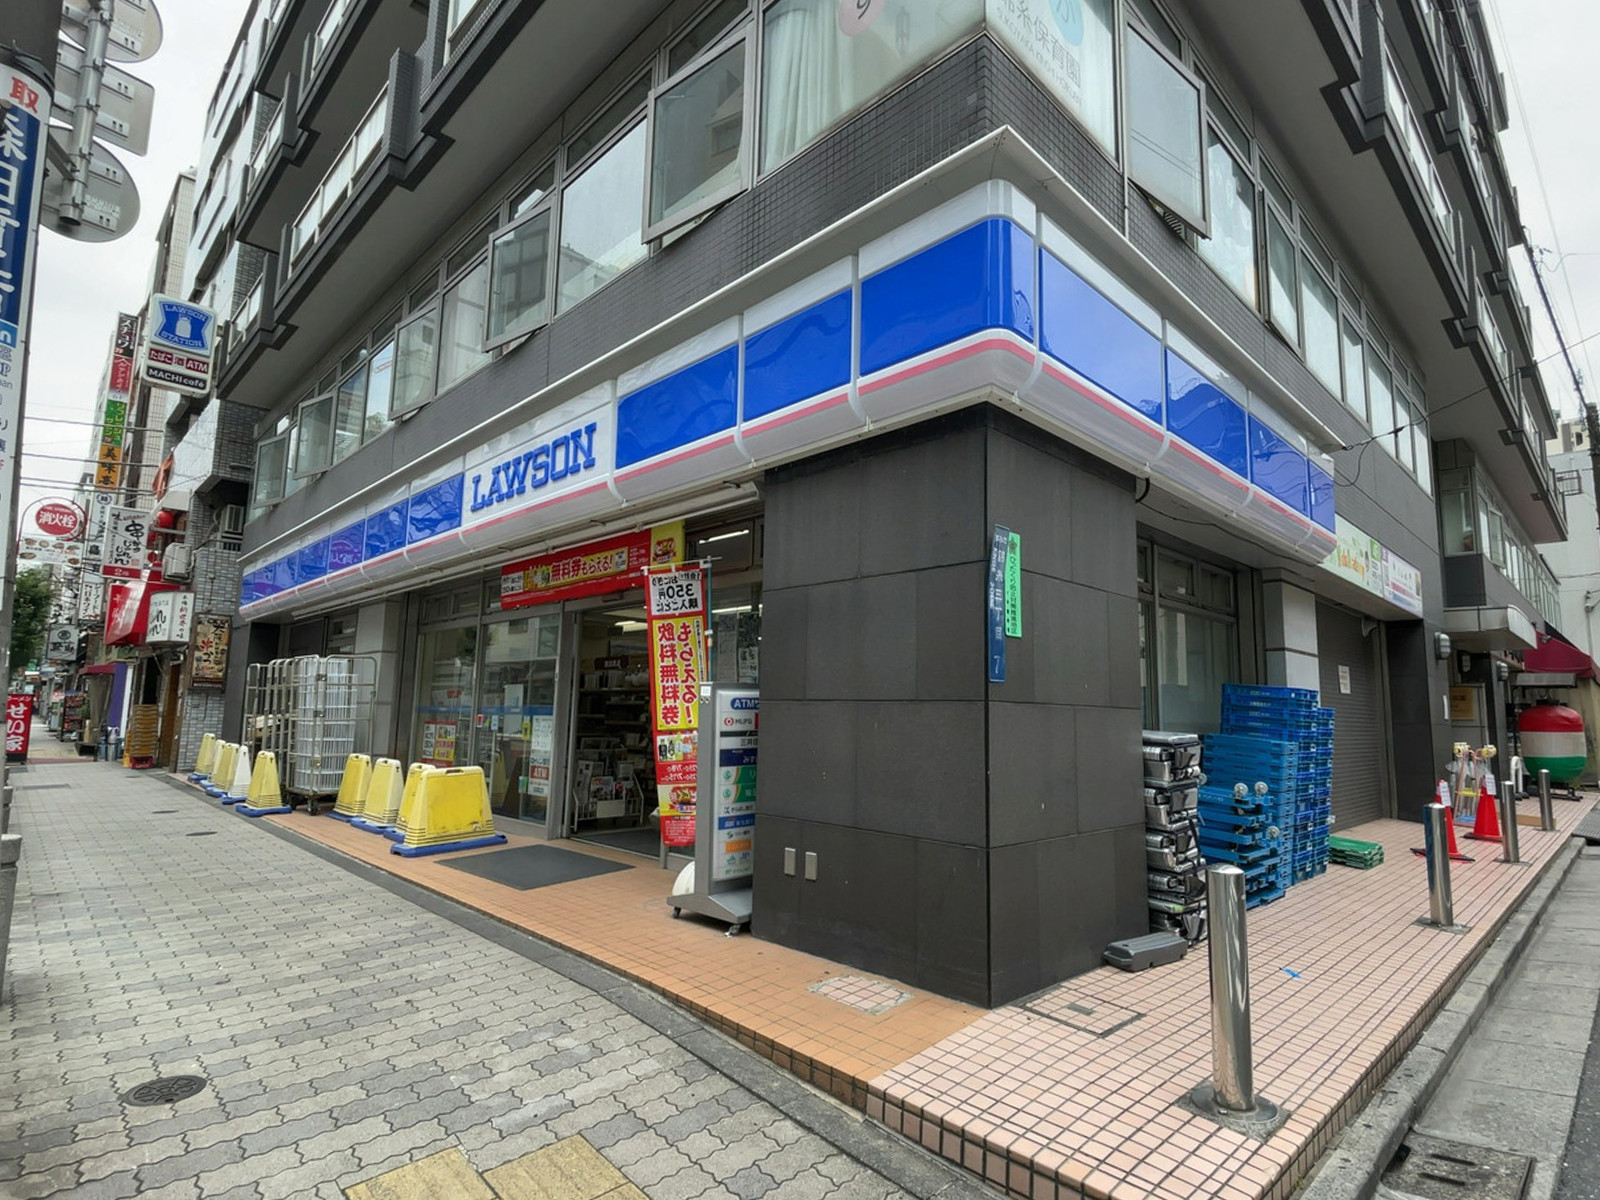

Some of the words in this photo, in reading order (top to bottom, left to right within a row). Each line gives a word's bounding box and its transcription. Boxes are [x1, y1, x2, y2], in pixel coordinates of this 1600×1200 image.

[165, 304, 208, 322] LAWSON
[161, 331, 203, 347] STATION
[150, 350, 172, 364] たばこ
[187, 361, 208, 373] ATM
[148, 368, 182, 382] MACHI
[470, 422, 597, 512] LAWSON
[38, 511, 76, 528] 消火栓
